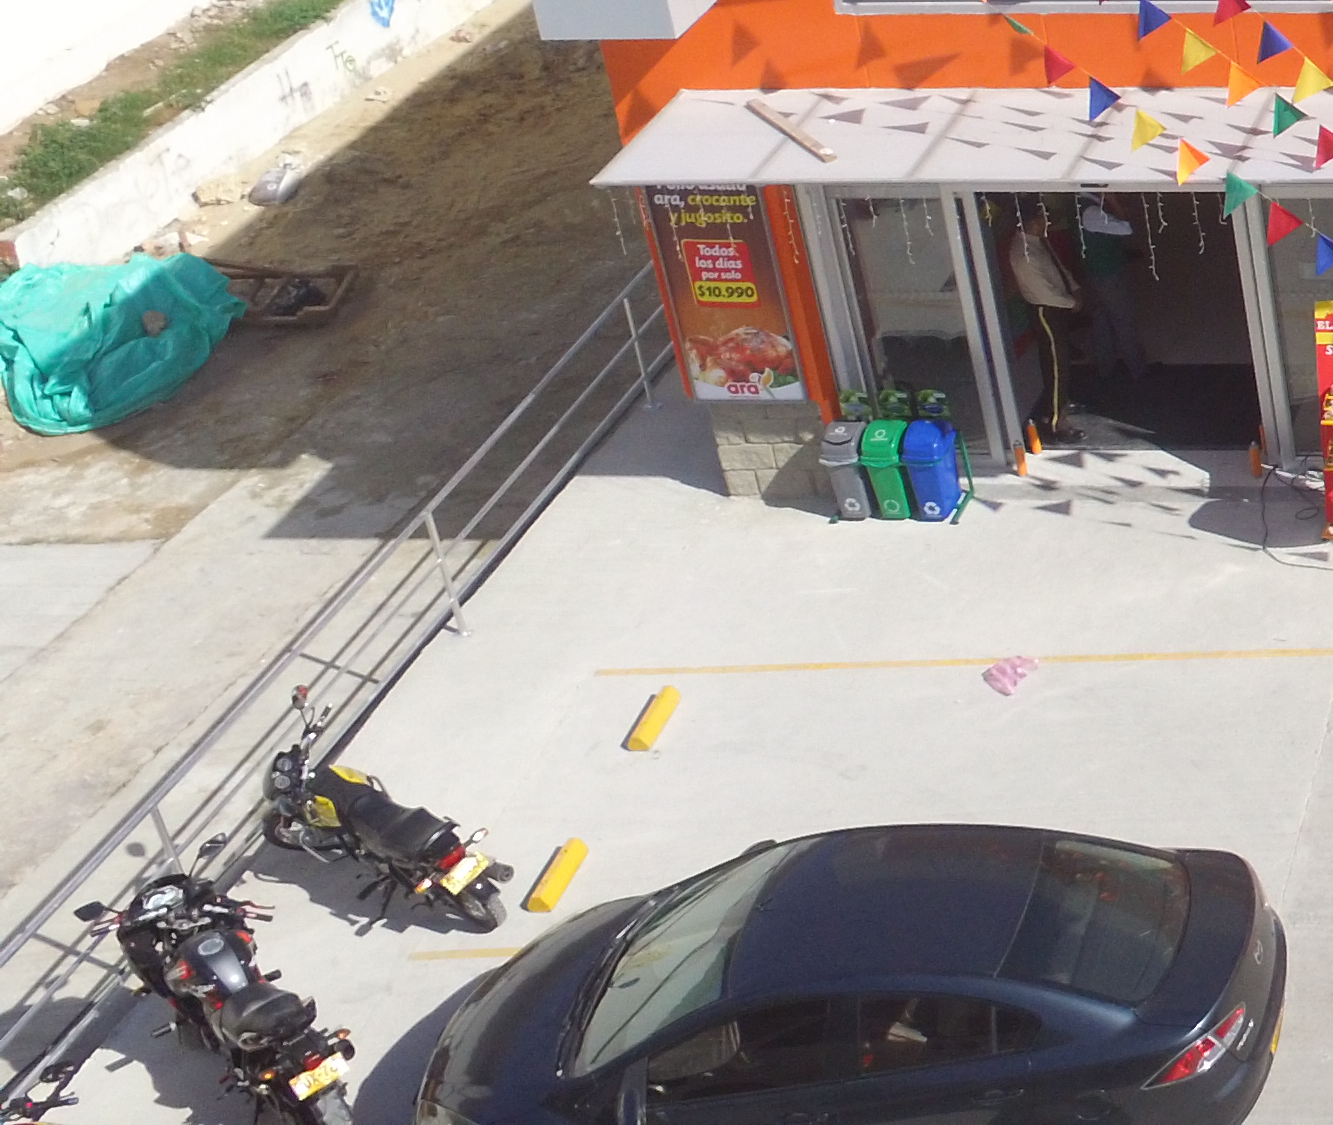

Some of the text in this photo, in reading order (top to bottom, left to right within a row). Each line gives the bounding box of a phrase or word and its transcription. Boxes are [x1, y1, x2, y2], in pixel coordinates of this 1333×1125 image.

[654, 194, 756, 207] ara, crocante
[681, 209, 748, 227] jugosito.
[697, 245, 735, 256] Todos
[695, 257, 713, 268] los
[701, 270, 742, 280] por solo
[697, 286, 755, 298] $10.990
[727, 383, 760, 395] ara
